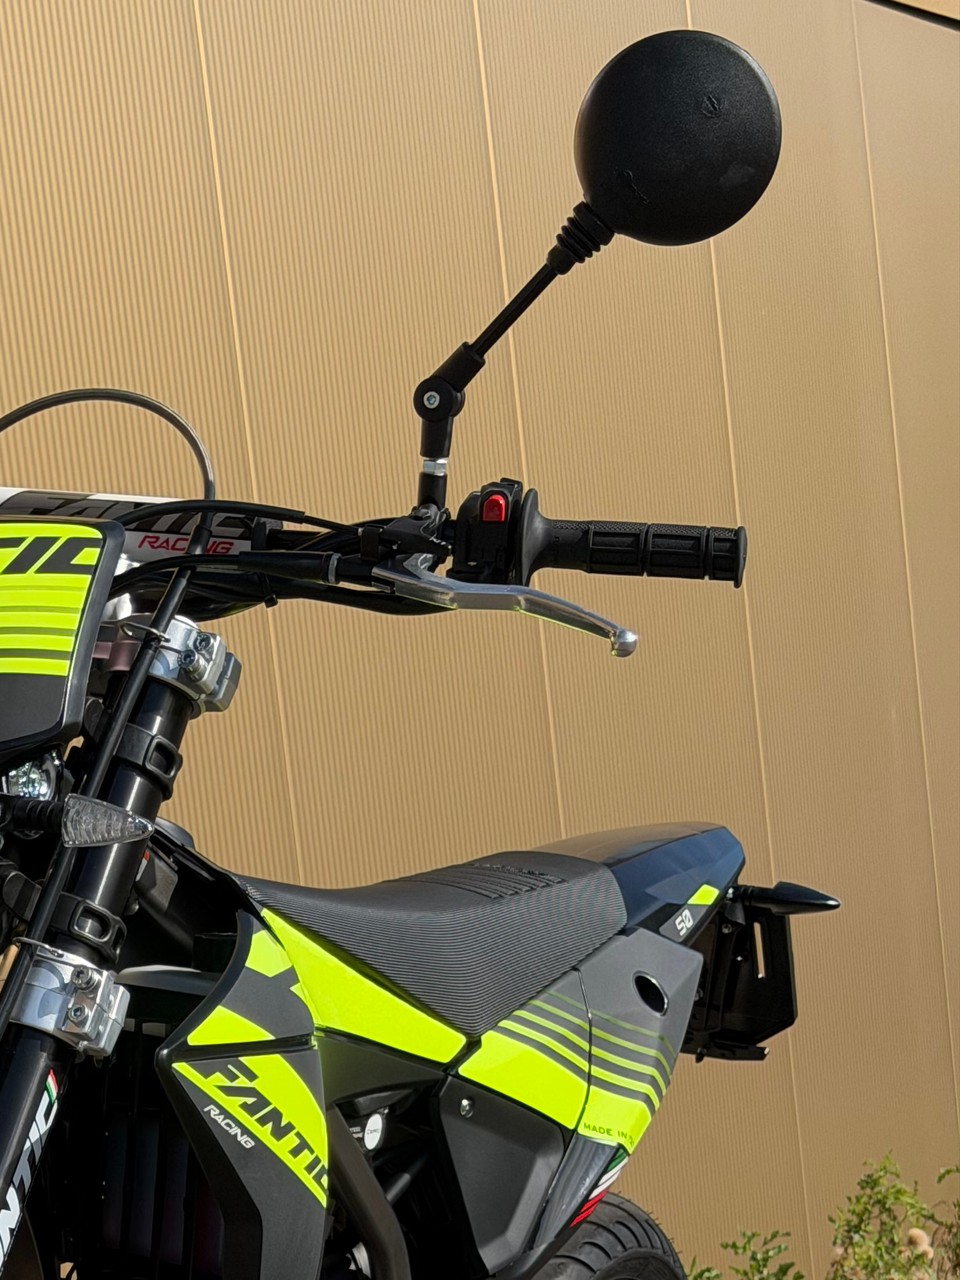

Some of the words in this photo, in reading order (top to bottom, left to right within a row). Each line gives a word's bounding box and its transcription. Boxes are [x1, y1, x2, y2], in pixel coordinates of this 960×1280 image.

[675, 909, 693, 936] 50
[204, 1104, 255, 1149] RACING
[584, 1122, 613, 1136] MADE
[617, 1130, 628, 1139] IN
